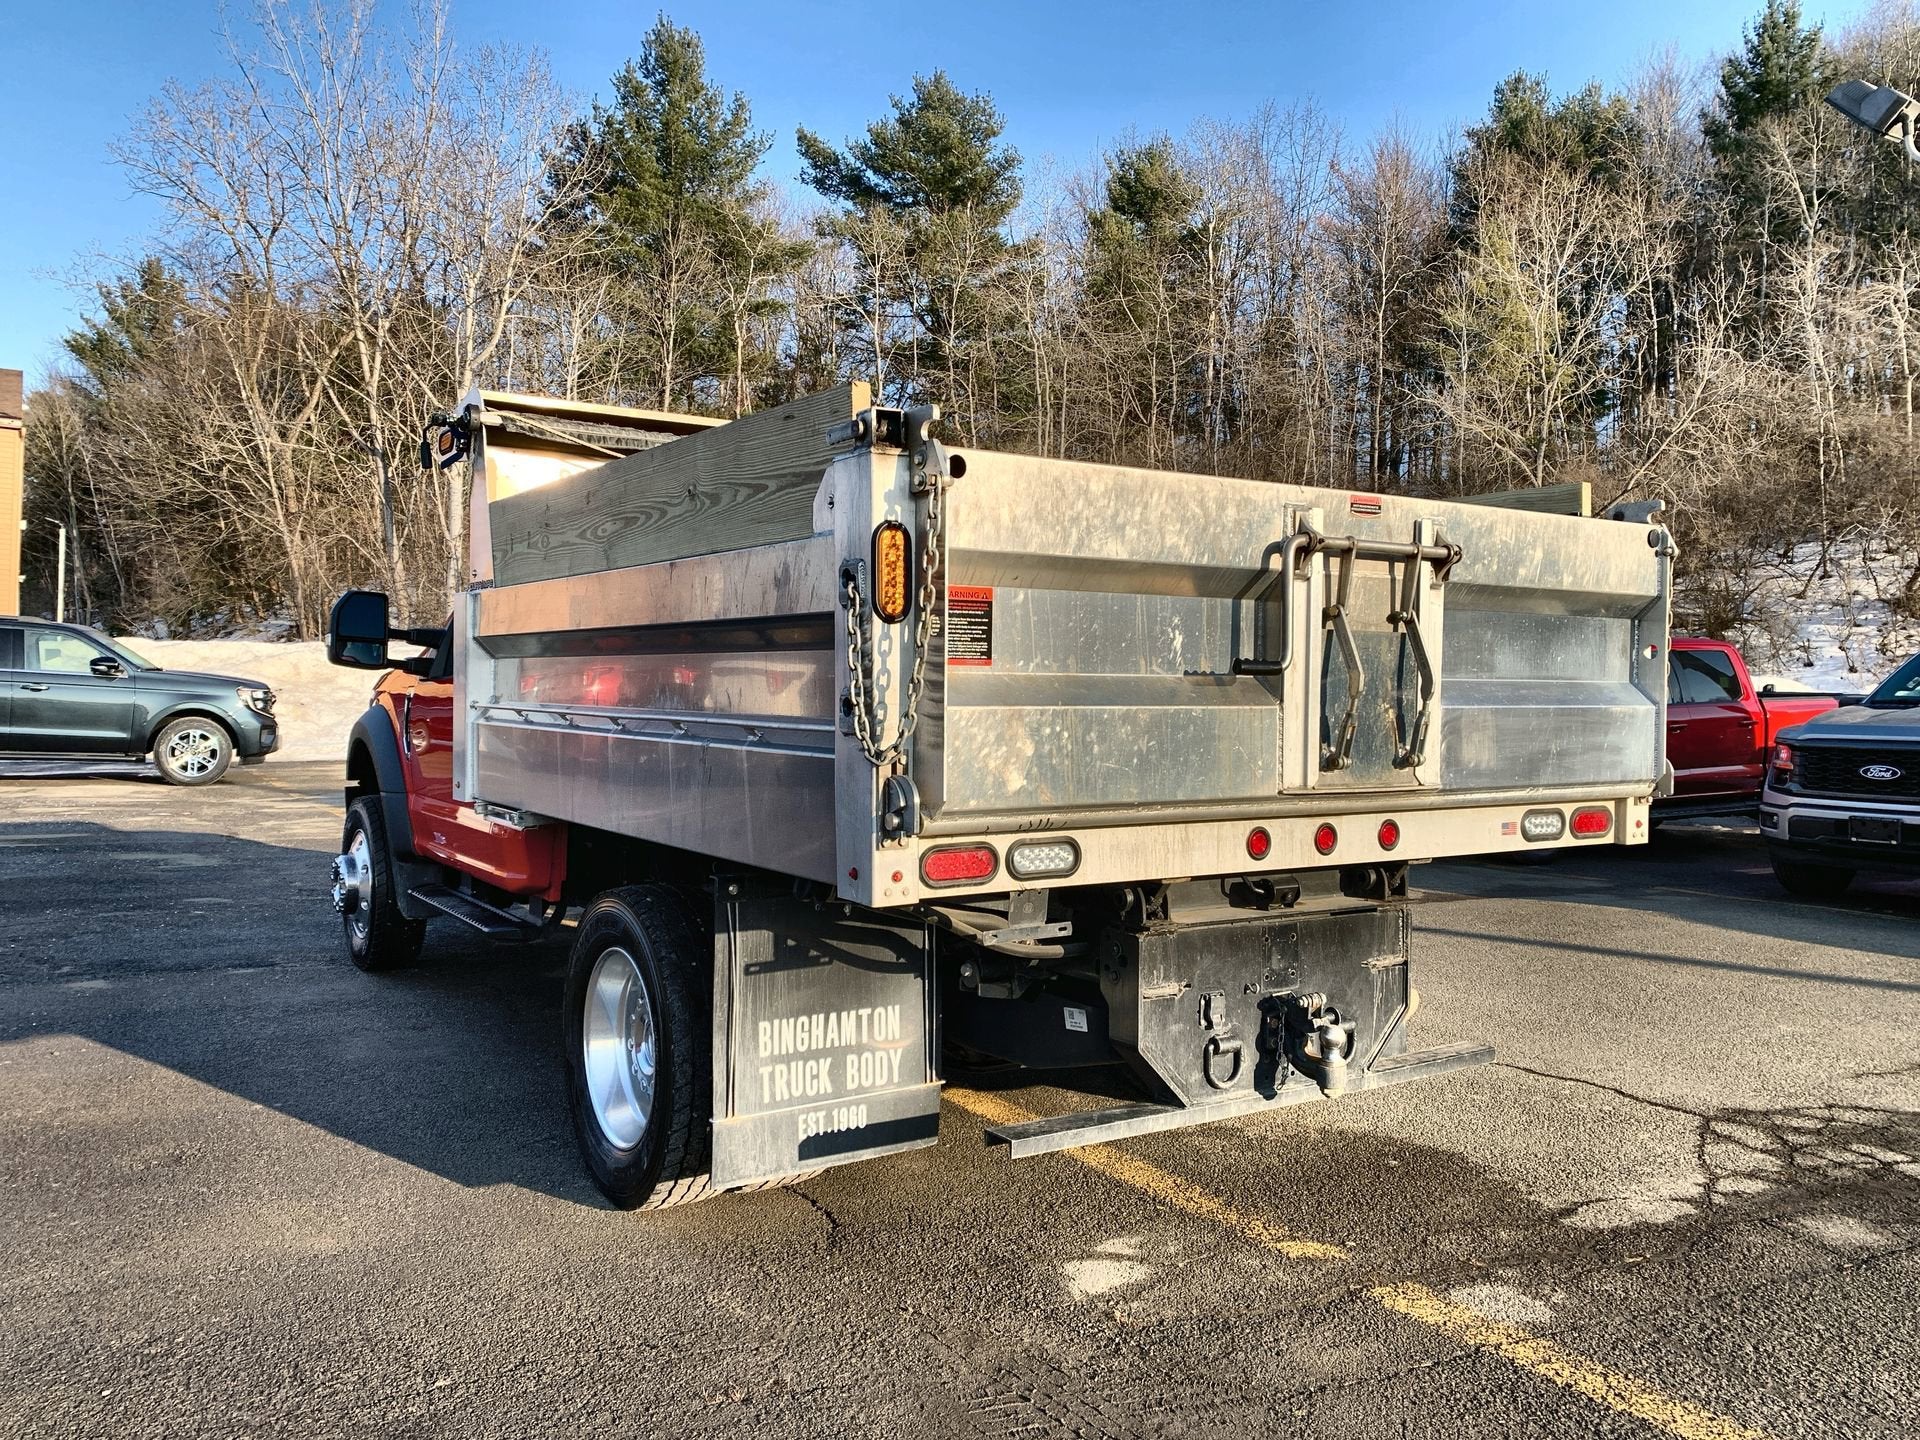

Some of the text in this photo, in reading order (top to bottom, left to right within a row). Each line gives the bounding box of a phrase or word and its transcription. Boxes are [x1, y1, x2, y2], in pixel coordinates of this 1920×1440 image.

[948, 590, 980, 599] ARNING
[1867, 767, 1893, 778] Ford
[758, 1005, 901, 1058] BINGHAMTON
[758, 1048, 902, 1104] TRUCK BODY
[798, 1104, 867, 1140] EST.1960
